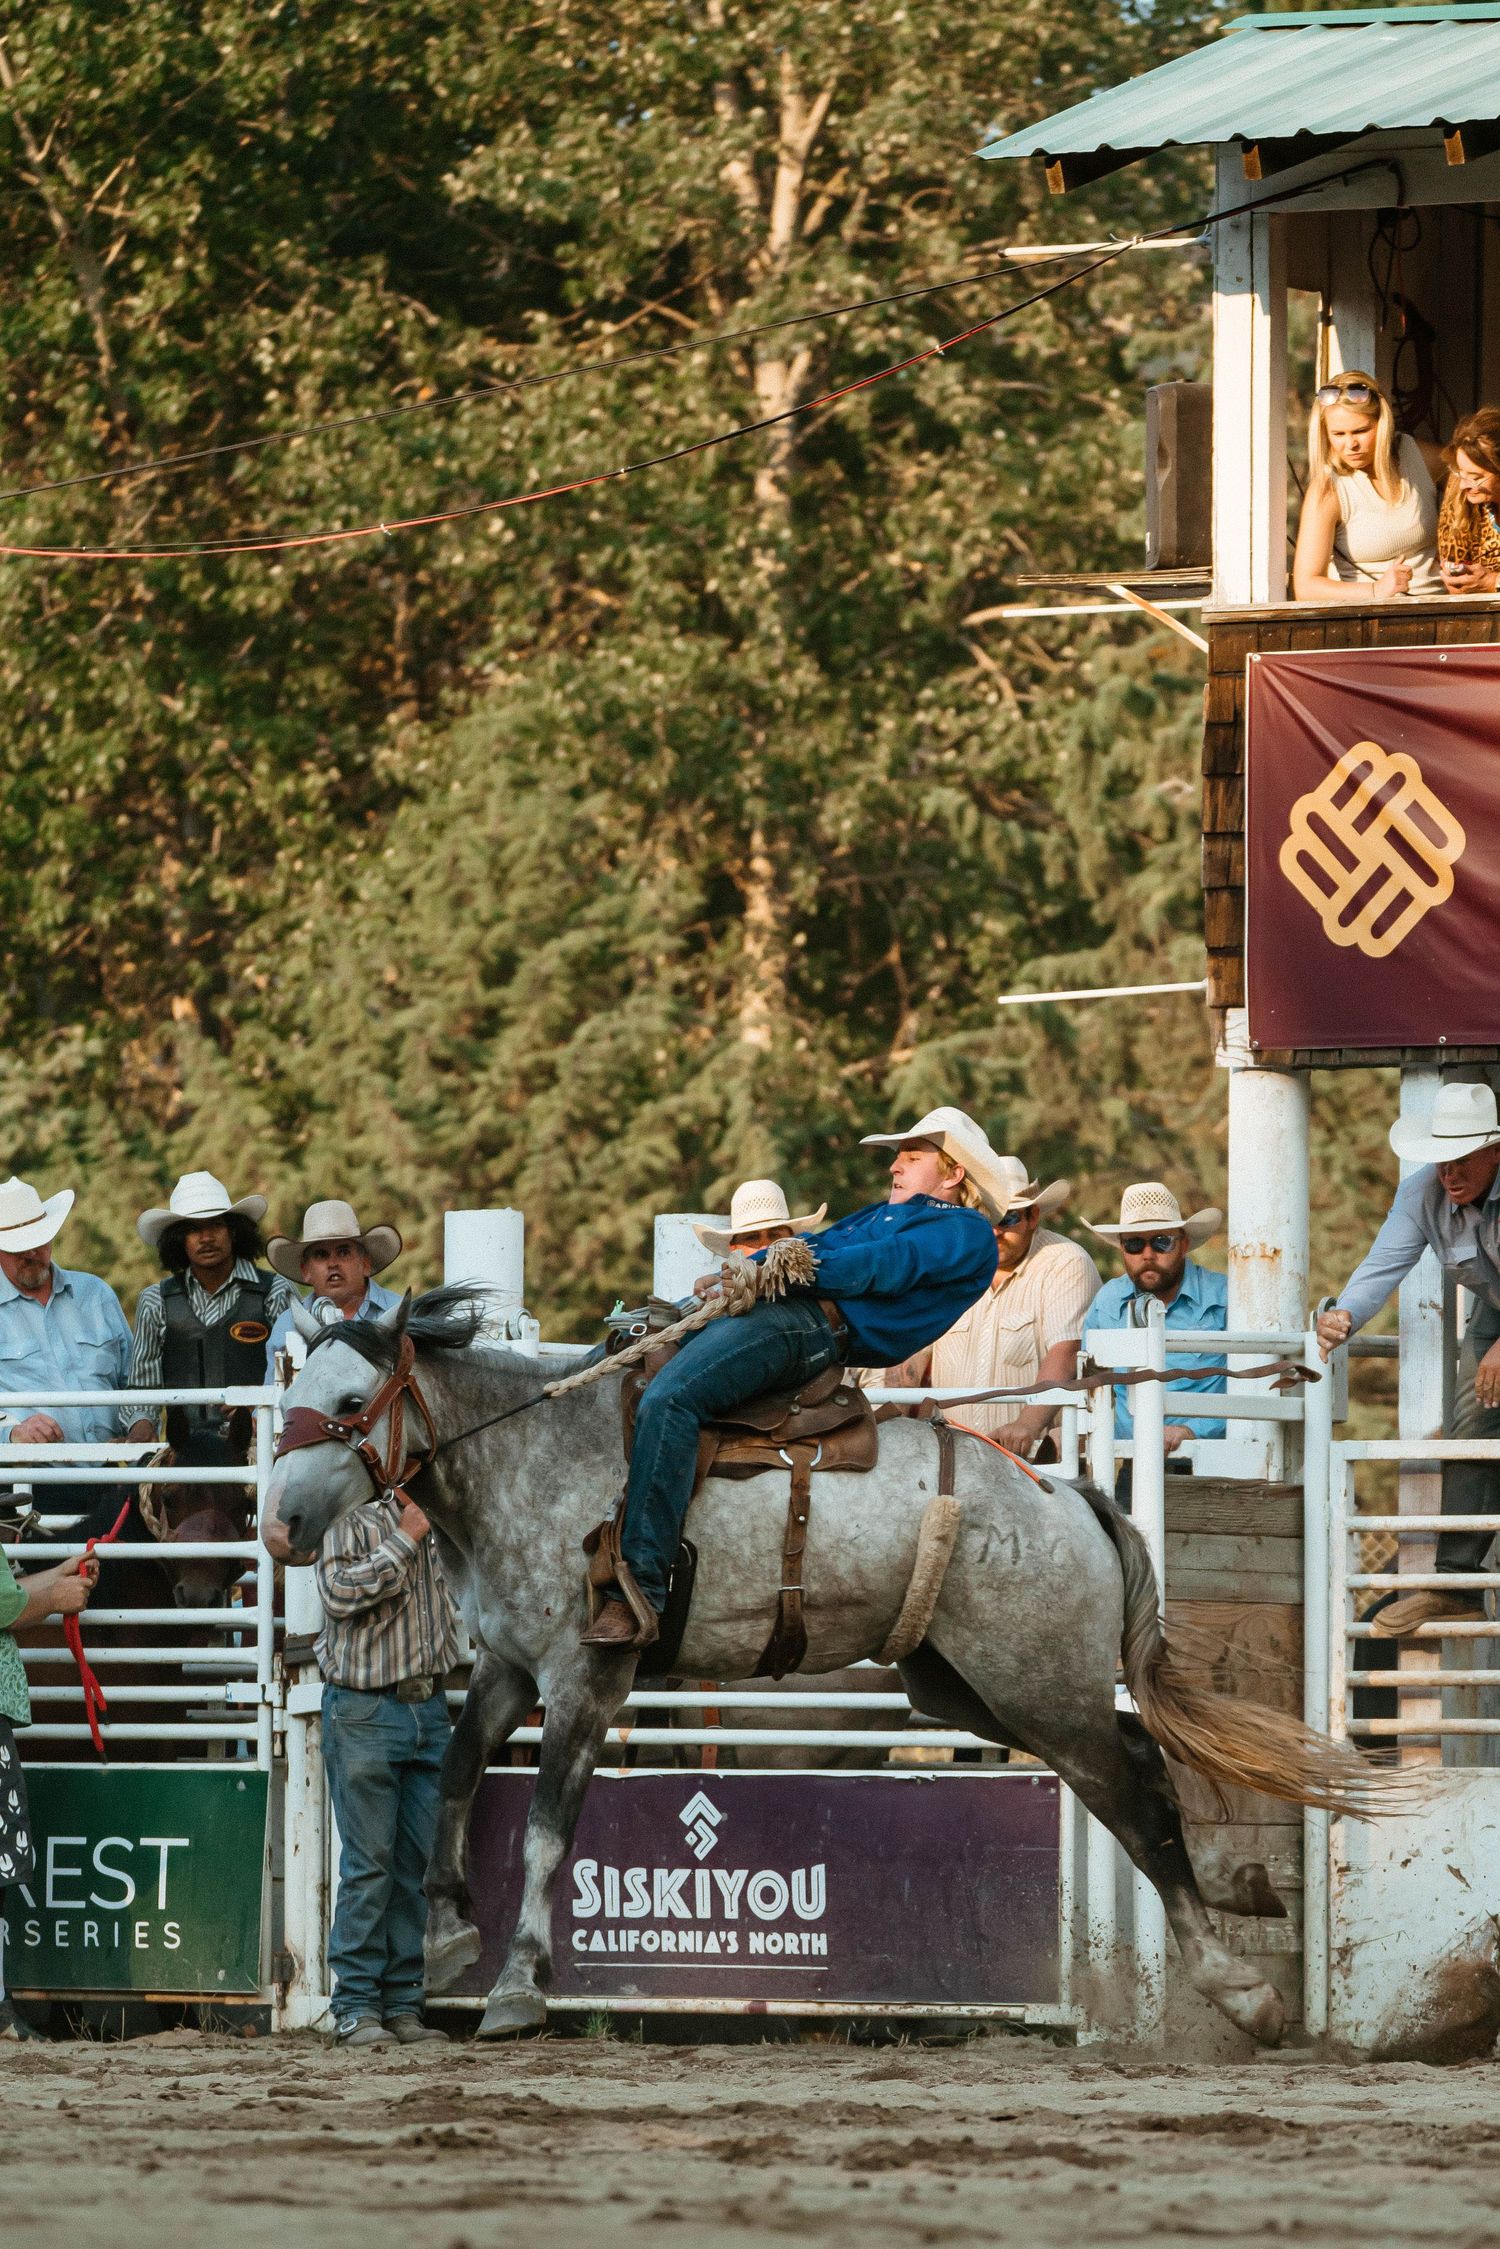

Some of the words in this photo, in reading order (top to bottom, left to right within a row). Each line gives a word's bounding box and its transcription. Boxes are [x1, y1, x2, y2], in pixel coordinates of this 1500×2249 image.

[572, 1858, 827, 1921] SISKIYOU
[572, 1929, 739, 1954] CALIFORNIA'S
[749, 1931, 828, 1956] NORTH
